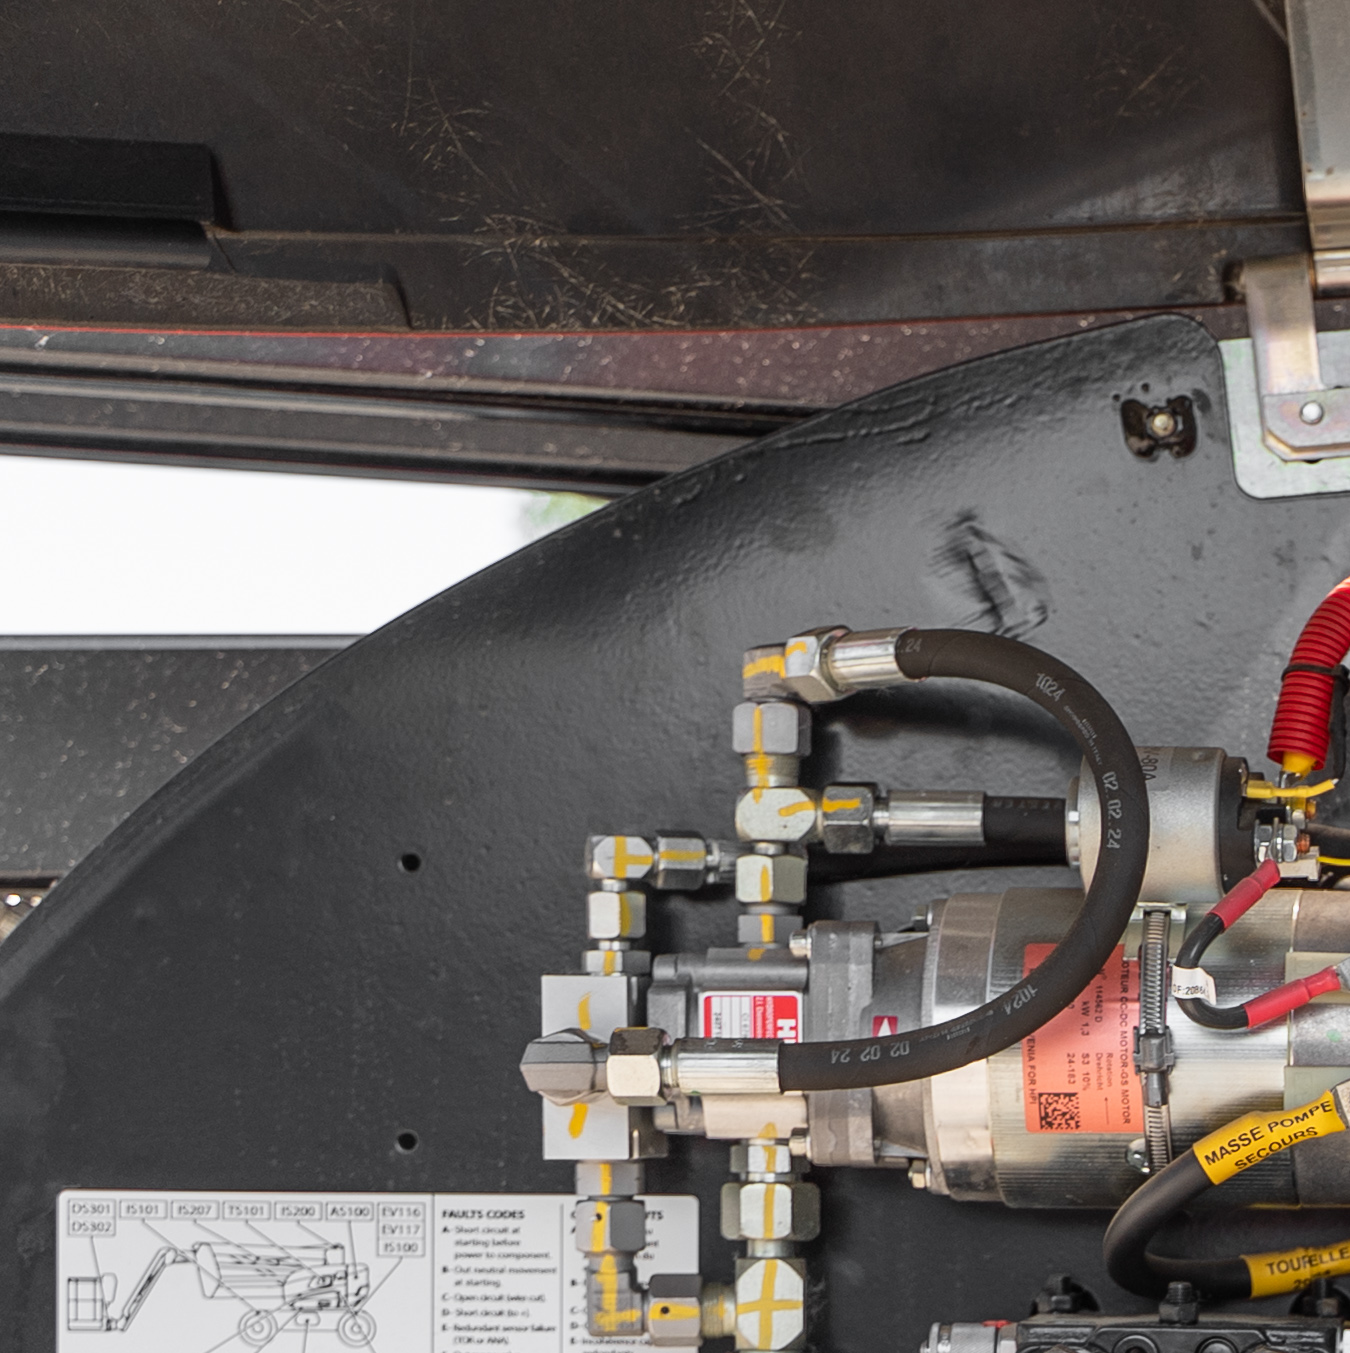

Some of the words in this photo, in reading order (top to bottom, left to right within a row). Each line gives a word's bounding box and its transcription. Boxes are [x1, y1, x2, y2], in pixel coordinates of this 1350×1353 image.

[1028, 1065, 1037, 1086] FOR
[1121, 1088, 1131, 1125] MOTOR
[1204, 1127, 1265, 1166] MASSE
[1266, 1100, 1334, 1133] POMPE
[1234, 1125, 1319, 1169] SECOURS
[72, 1203, 111, 1215] DS301
[126, 1204, 159, 1215] IS101
[178, 1204, 212, 1215] IS207
[282, 1205, 316, 1216] IS200
[330, 1205, 370, 1217] AS100
[382, 1206, 421, 1218] EV116
[442, 1210, 484, 1219] FAULTS
[486, 1210, 525, 1219] CODES
[72, 1221, 112, 1233] DS302
[382, 1223, 421, 1235] EV117
[383, 1242, 419, 1253] IS100
